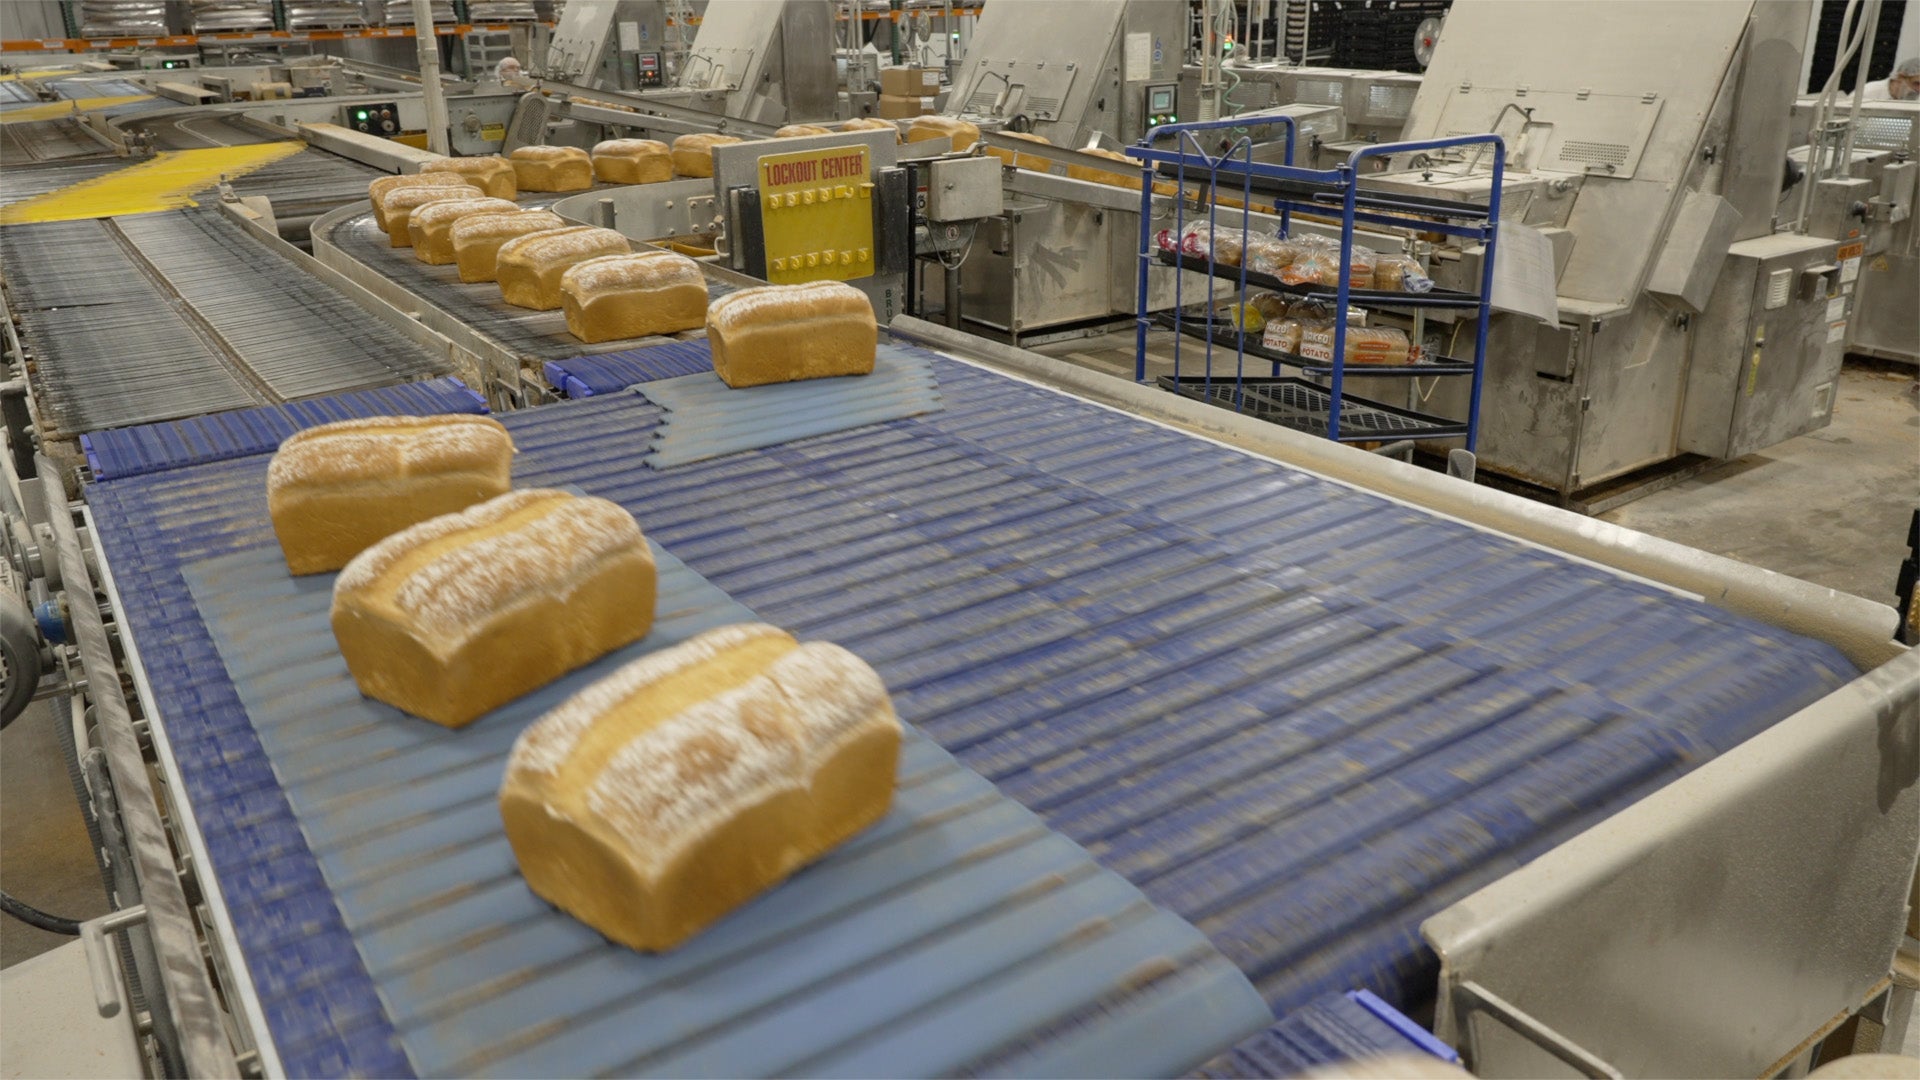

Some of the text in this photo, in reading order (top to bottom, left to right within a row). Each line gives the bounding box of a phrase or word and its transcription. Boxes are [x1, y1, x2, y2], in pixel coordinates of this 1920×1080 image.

[766, 154, 864, 187] LOCKOUT CENTER
[1264, 338, 1288, 348] POTATO
[1302, 347, 1330, 360] POTATO
